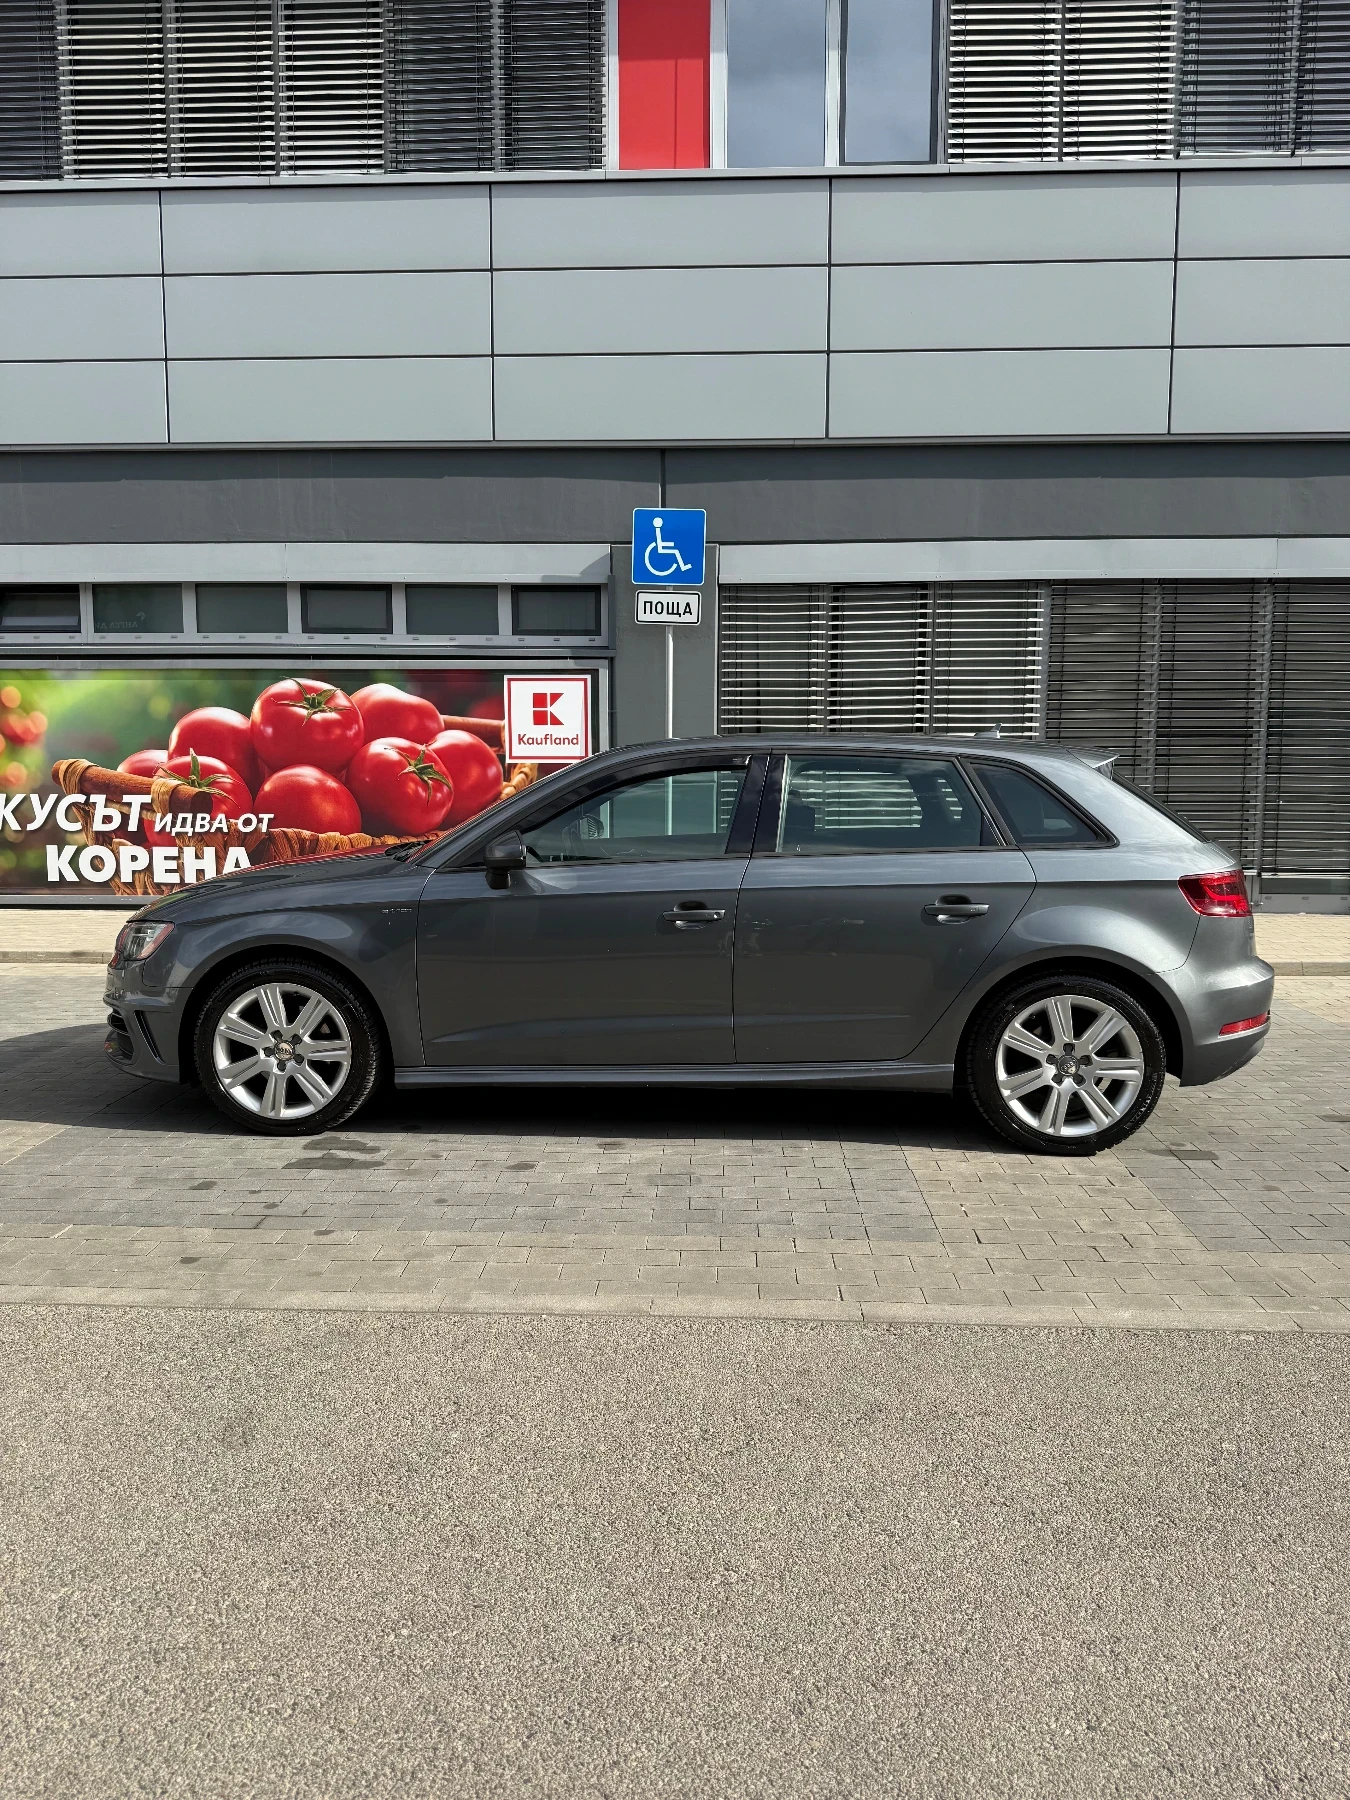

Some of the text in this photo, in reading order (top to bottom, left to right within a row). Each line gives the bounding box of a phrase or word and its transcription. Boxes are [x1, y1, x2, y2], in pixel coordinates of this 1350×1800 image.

[643, 600, 693, 617] ПОЩА
[533, 692, 565, 725] K
[517, 733, 579, 745] Kaufland
[0, 793, 275, 837] КУСЪТ ИДВА ОТ
[45, 844, 252, 883] КОРЕНА
